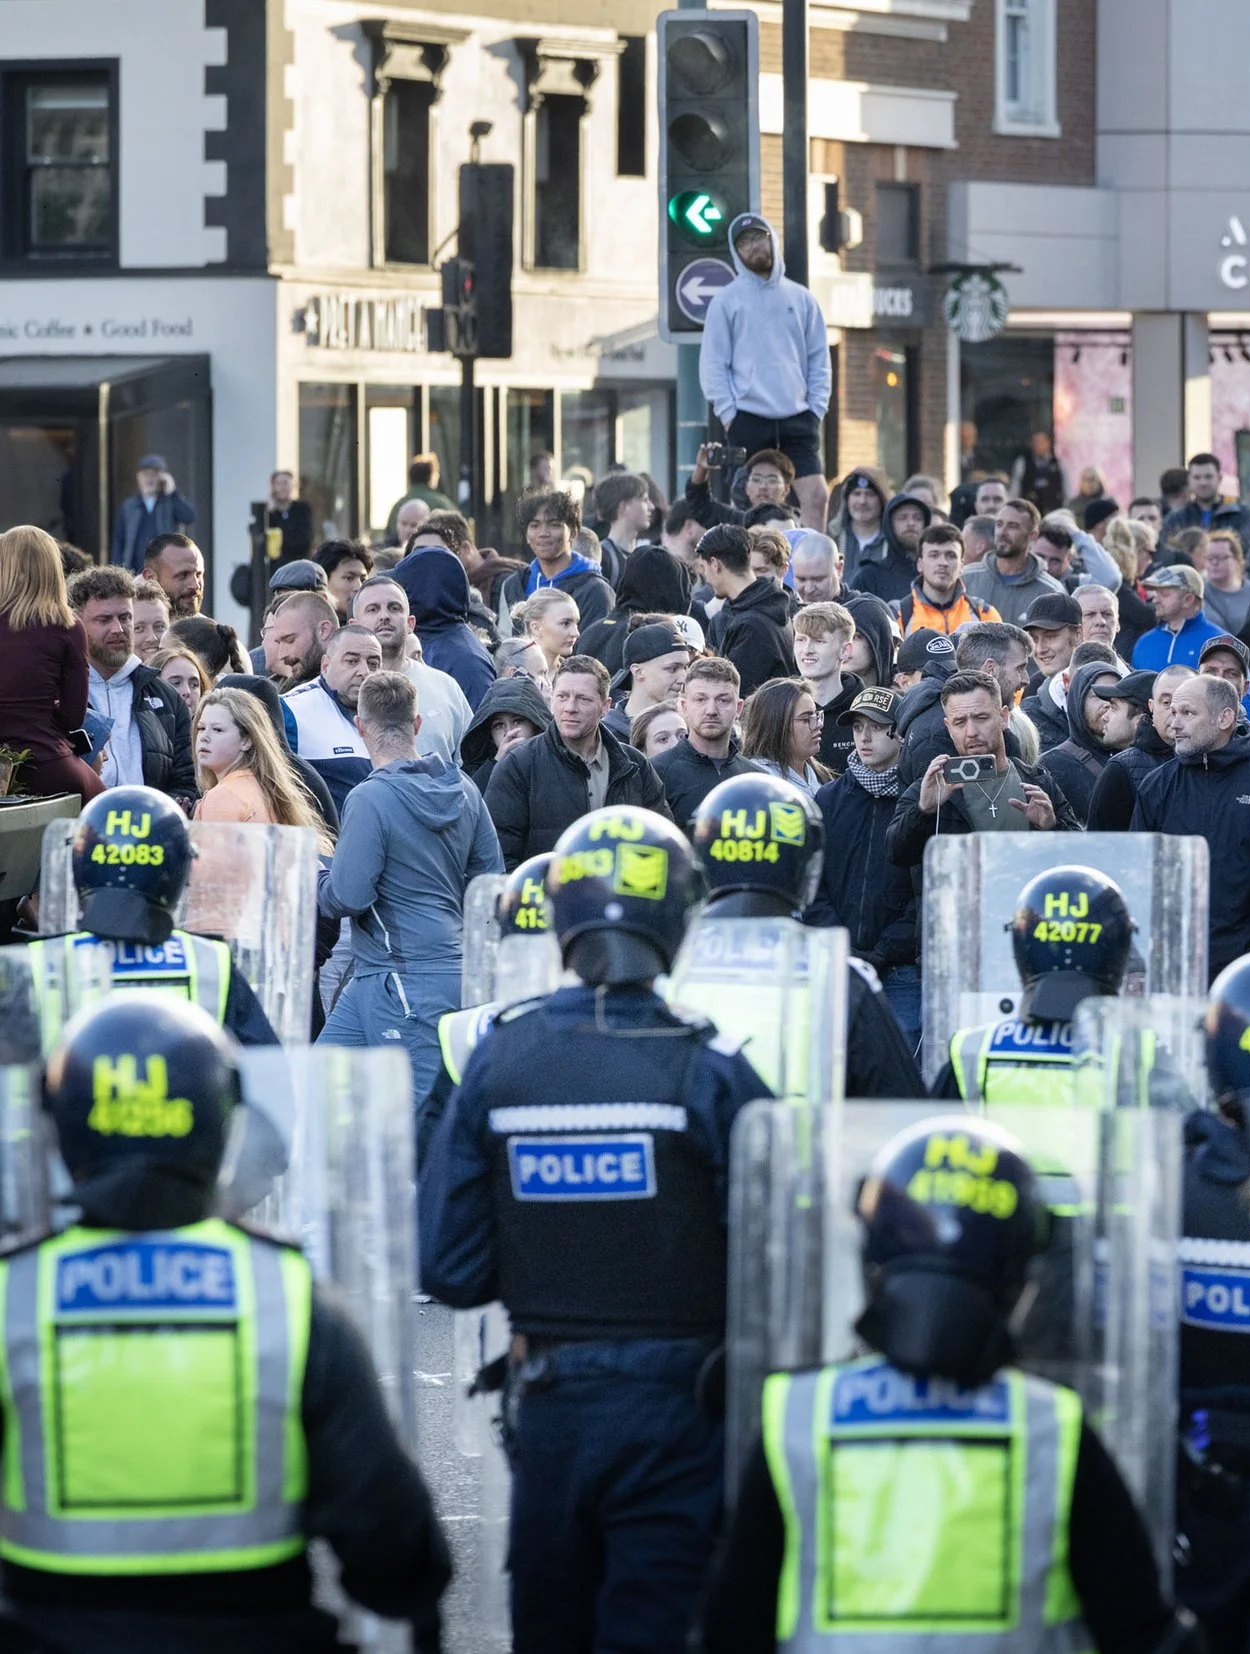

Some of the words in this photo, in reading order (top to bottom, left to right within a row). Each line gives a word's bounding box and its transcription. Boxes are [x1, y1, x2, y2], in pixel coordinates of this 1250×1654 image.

[23, 319, 76, 339] Coffee
[101, 317, 147, 338] Good
[152, 317, 193, 337] Food
[105, 810, 152, 838] HJ
[721, 809, 767, 839] HJ
[91, 844, 164, 866] 42083
[709, 839, 780, 863] 40814
[1044, 892, 1089, 918] HJ
[1033, 921, 1103, 944] 42077
[93, 1053, 168, 1100] HJ
[519, 1152, 644, 1185] POLICE
[924, 1133, 998, 1176] HJ
[62, 1251, 237, 1303] POLICE
